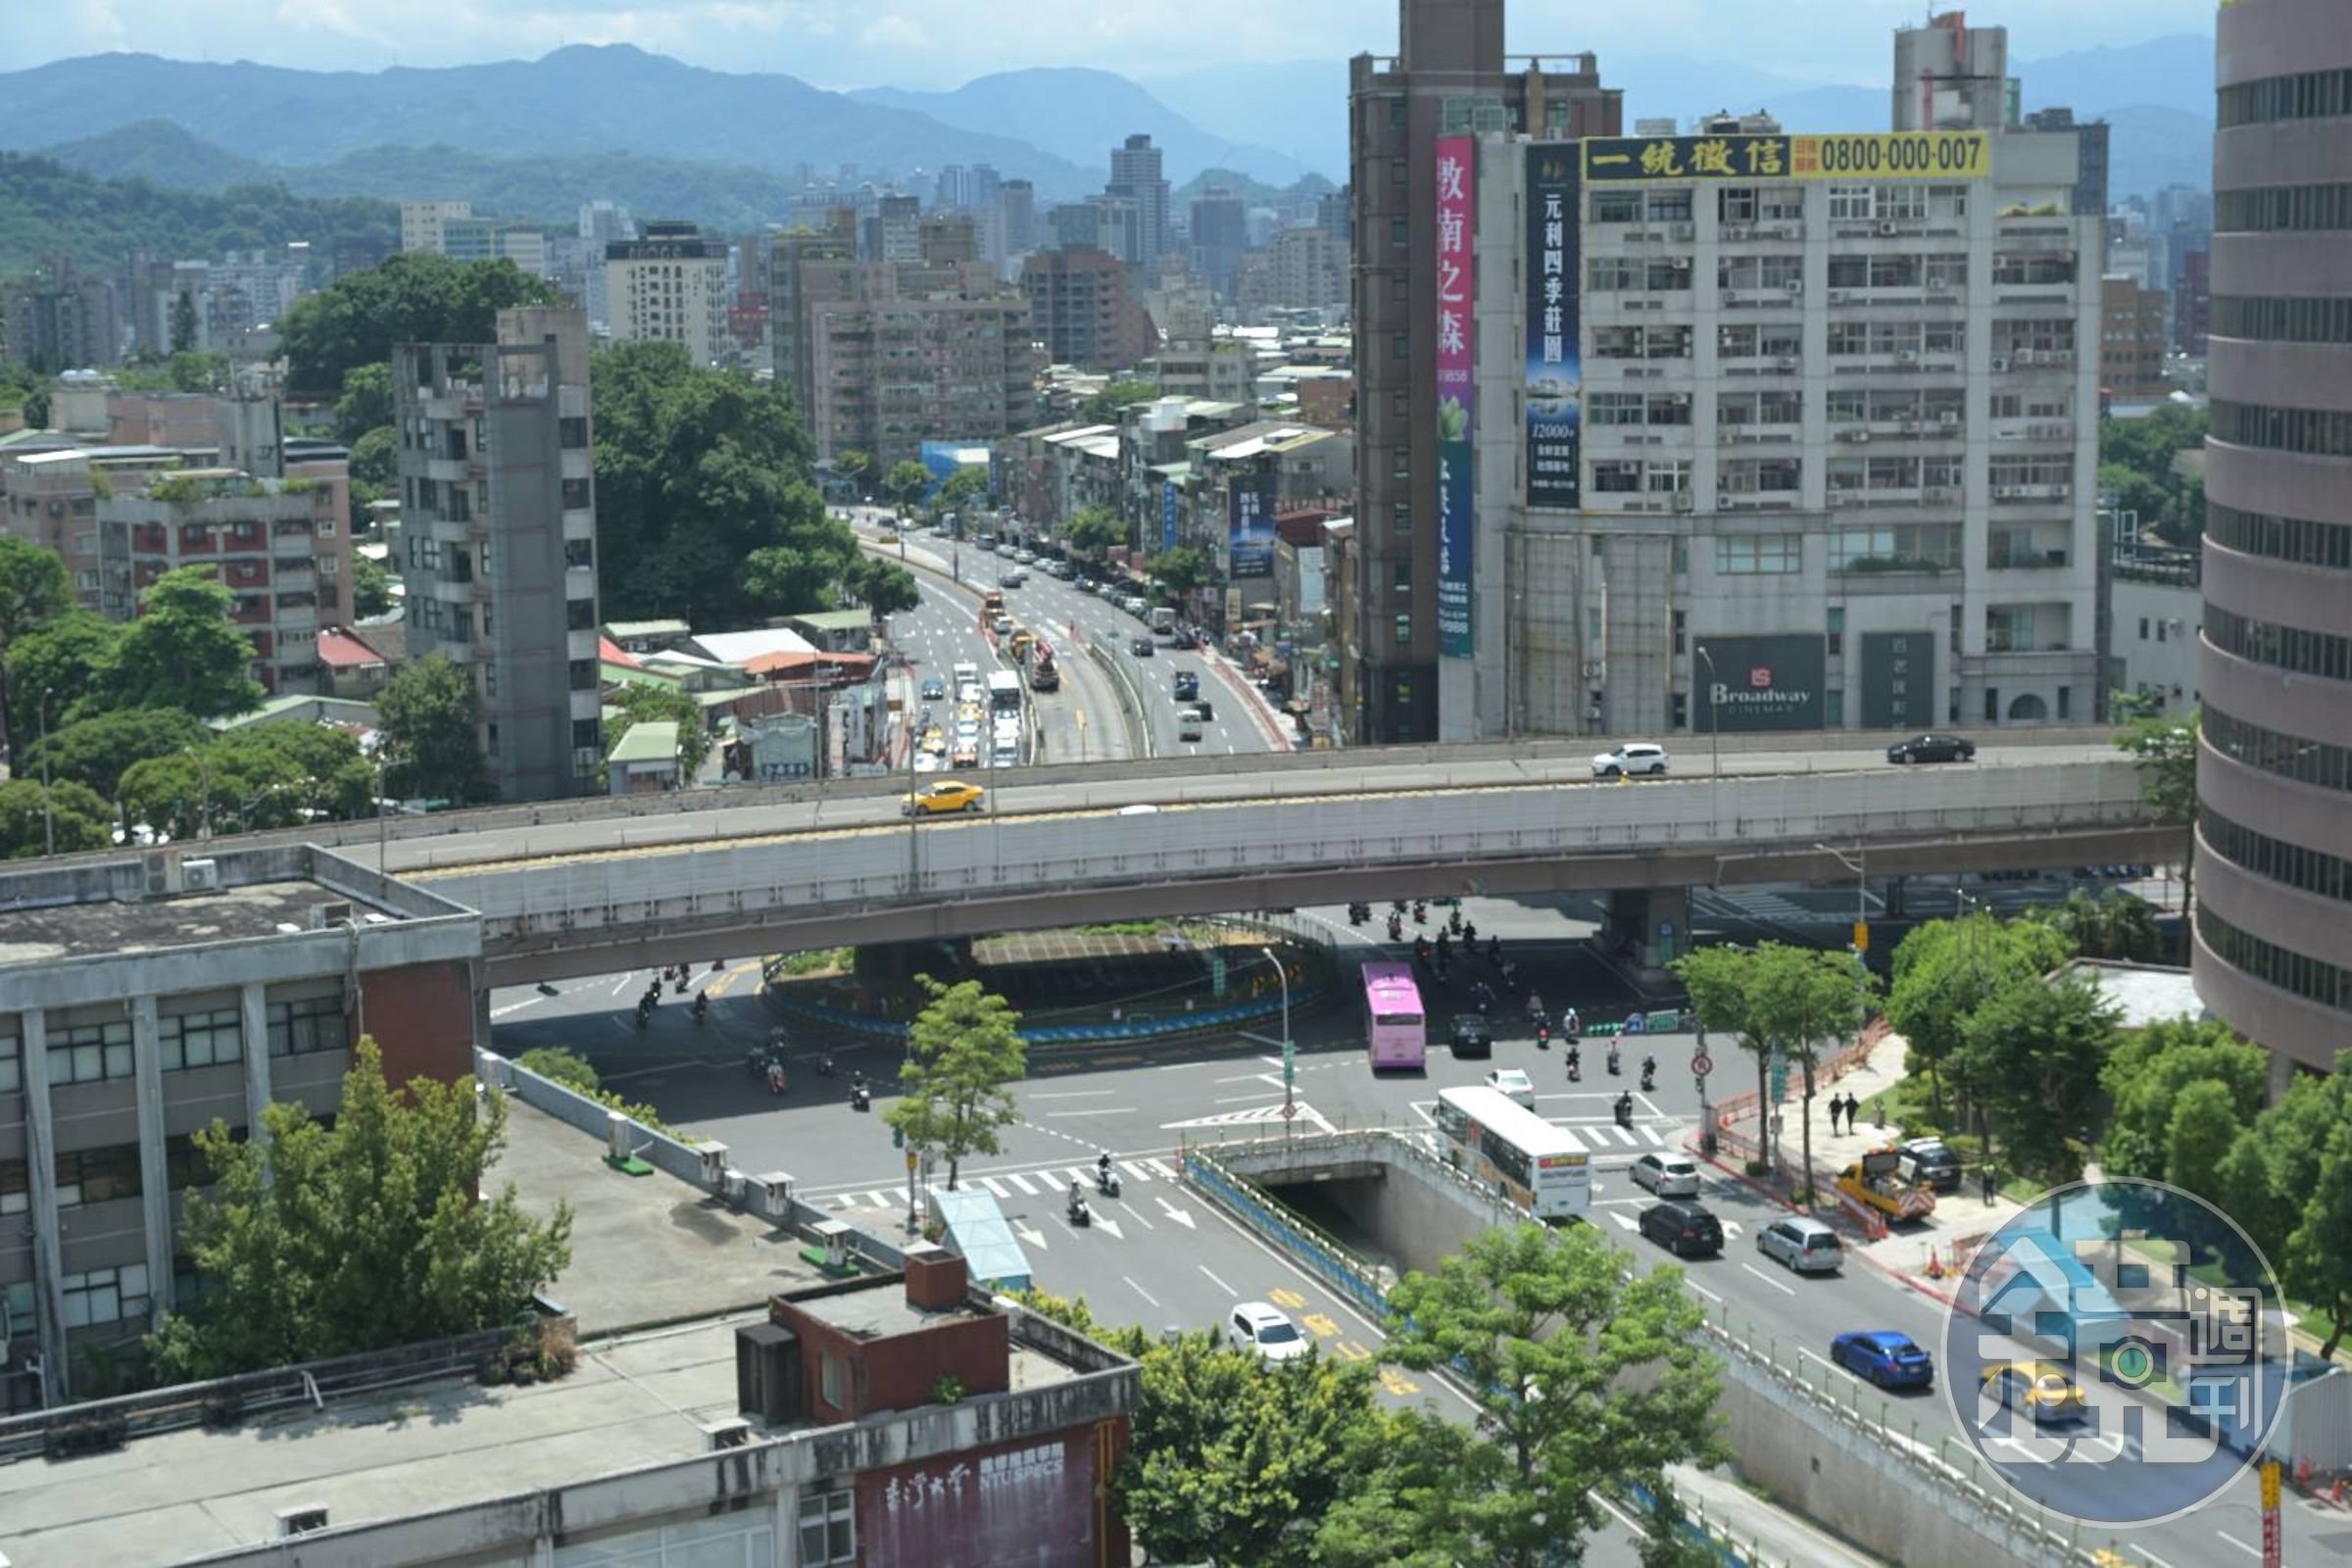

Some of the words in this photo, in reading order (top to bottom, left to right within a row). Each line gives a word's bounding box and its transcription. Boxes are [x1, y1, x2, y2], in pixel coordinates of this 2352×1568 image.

[1592, 138, 1784, 175] 一統徵信
[1544, 193, 1564, 364] 元利四季莊園
[1710, 683, 1810, 705] Broadway
